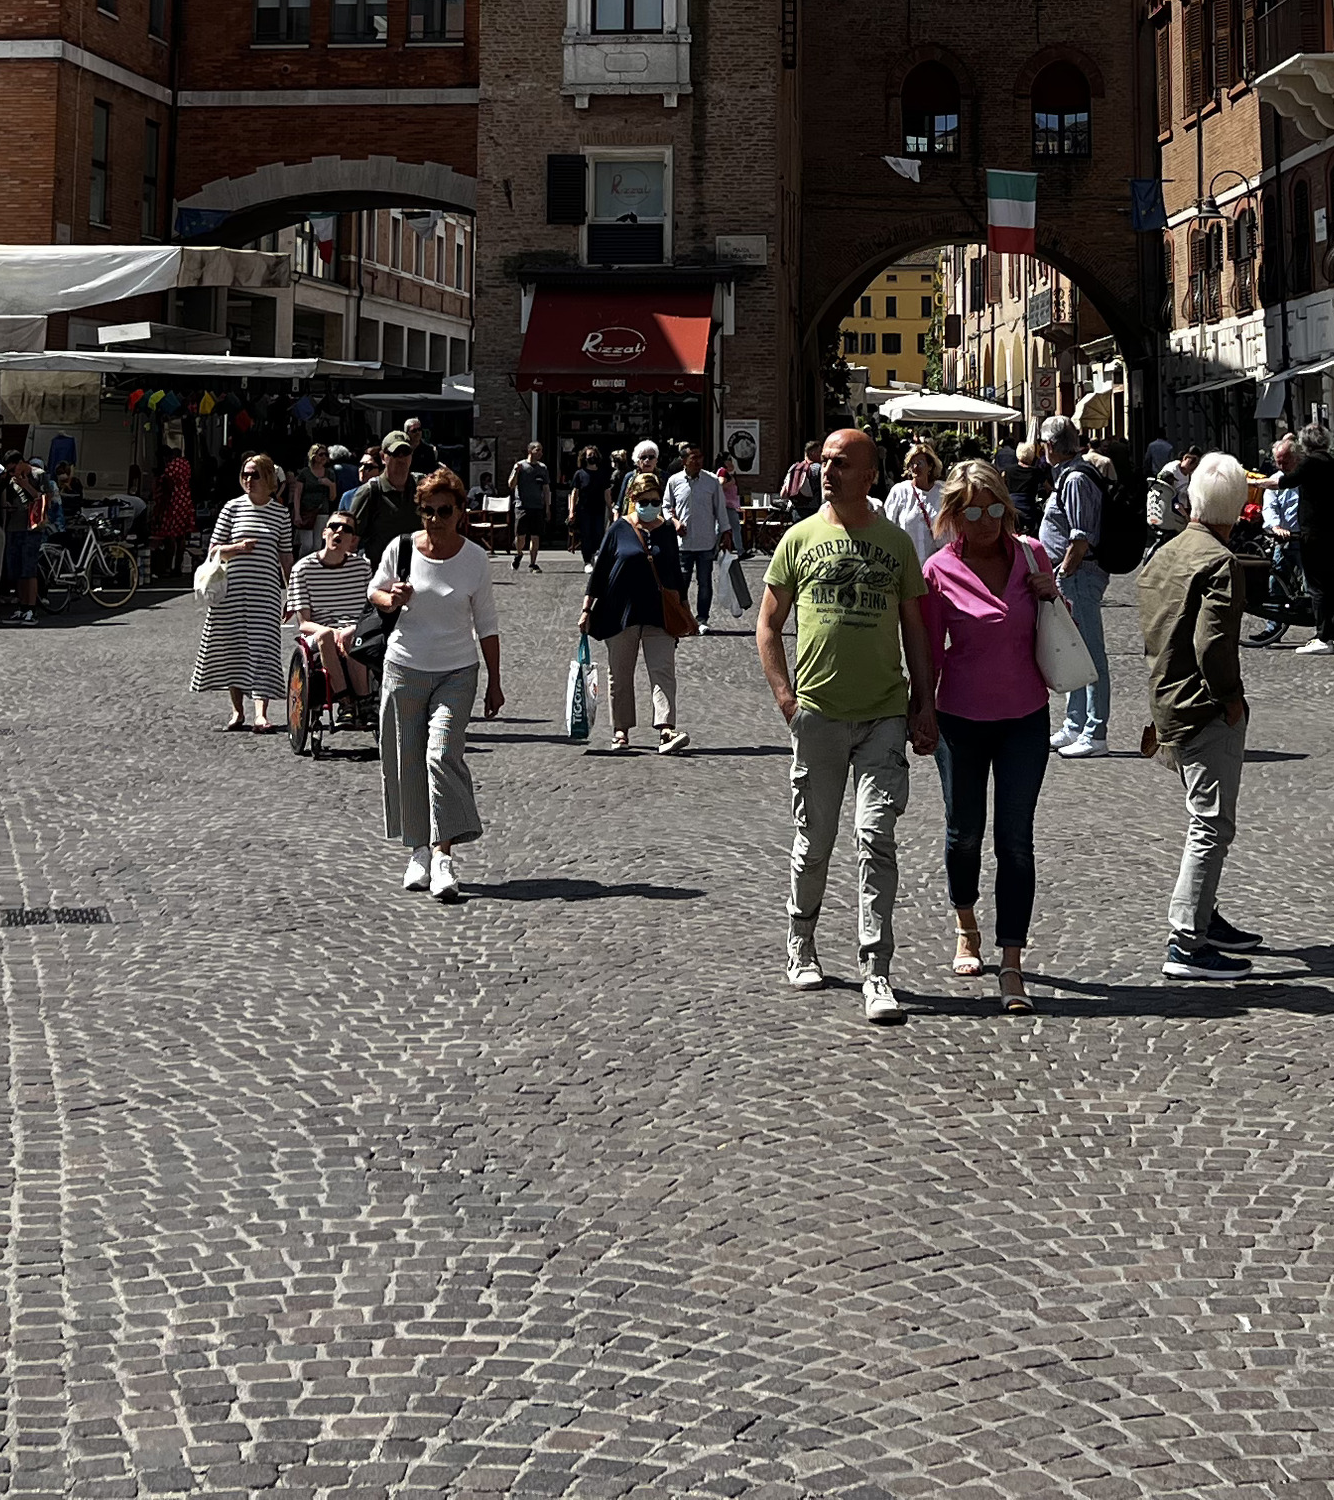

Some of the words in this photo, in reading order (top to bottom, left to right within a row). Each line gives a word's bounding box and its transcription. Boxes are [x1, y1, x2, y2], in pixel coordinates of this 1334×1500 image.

[799, 539, 872, 570] SCORPION
[874, 546, 900, 572] BAY
[812, 588, 835, 604] MAS
[861, 591, 887, 610] FINA
